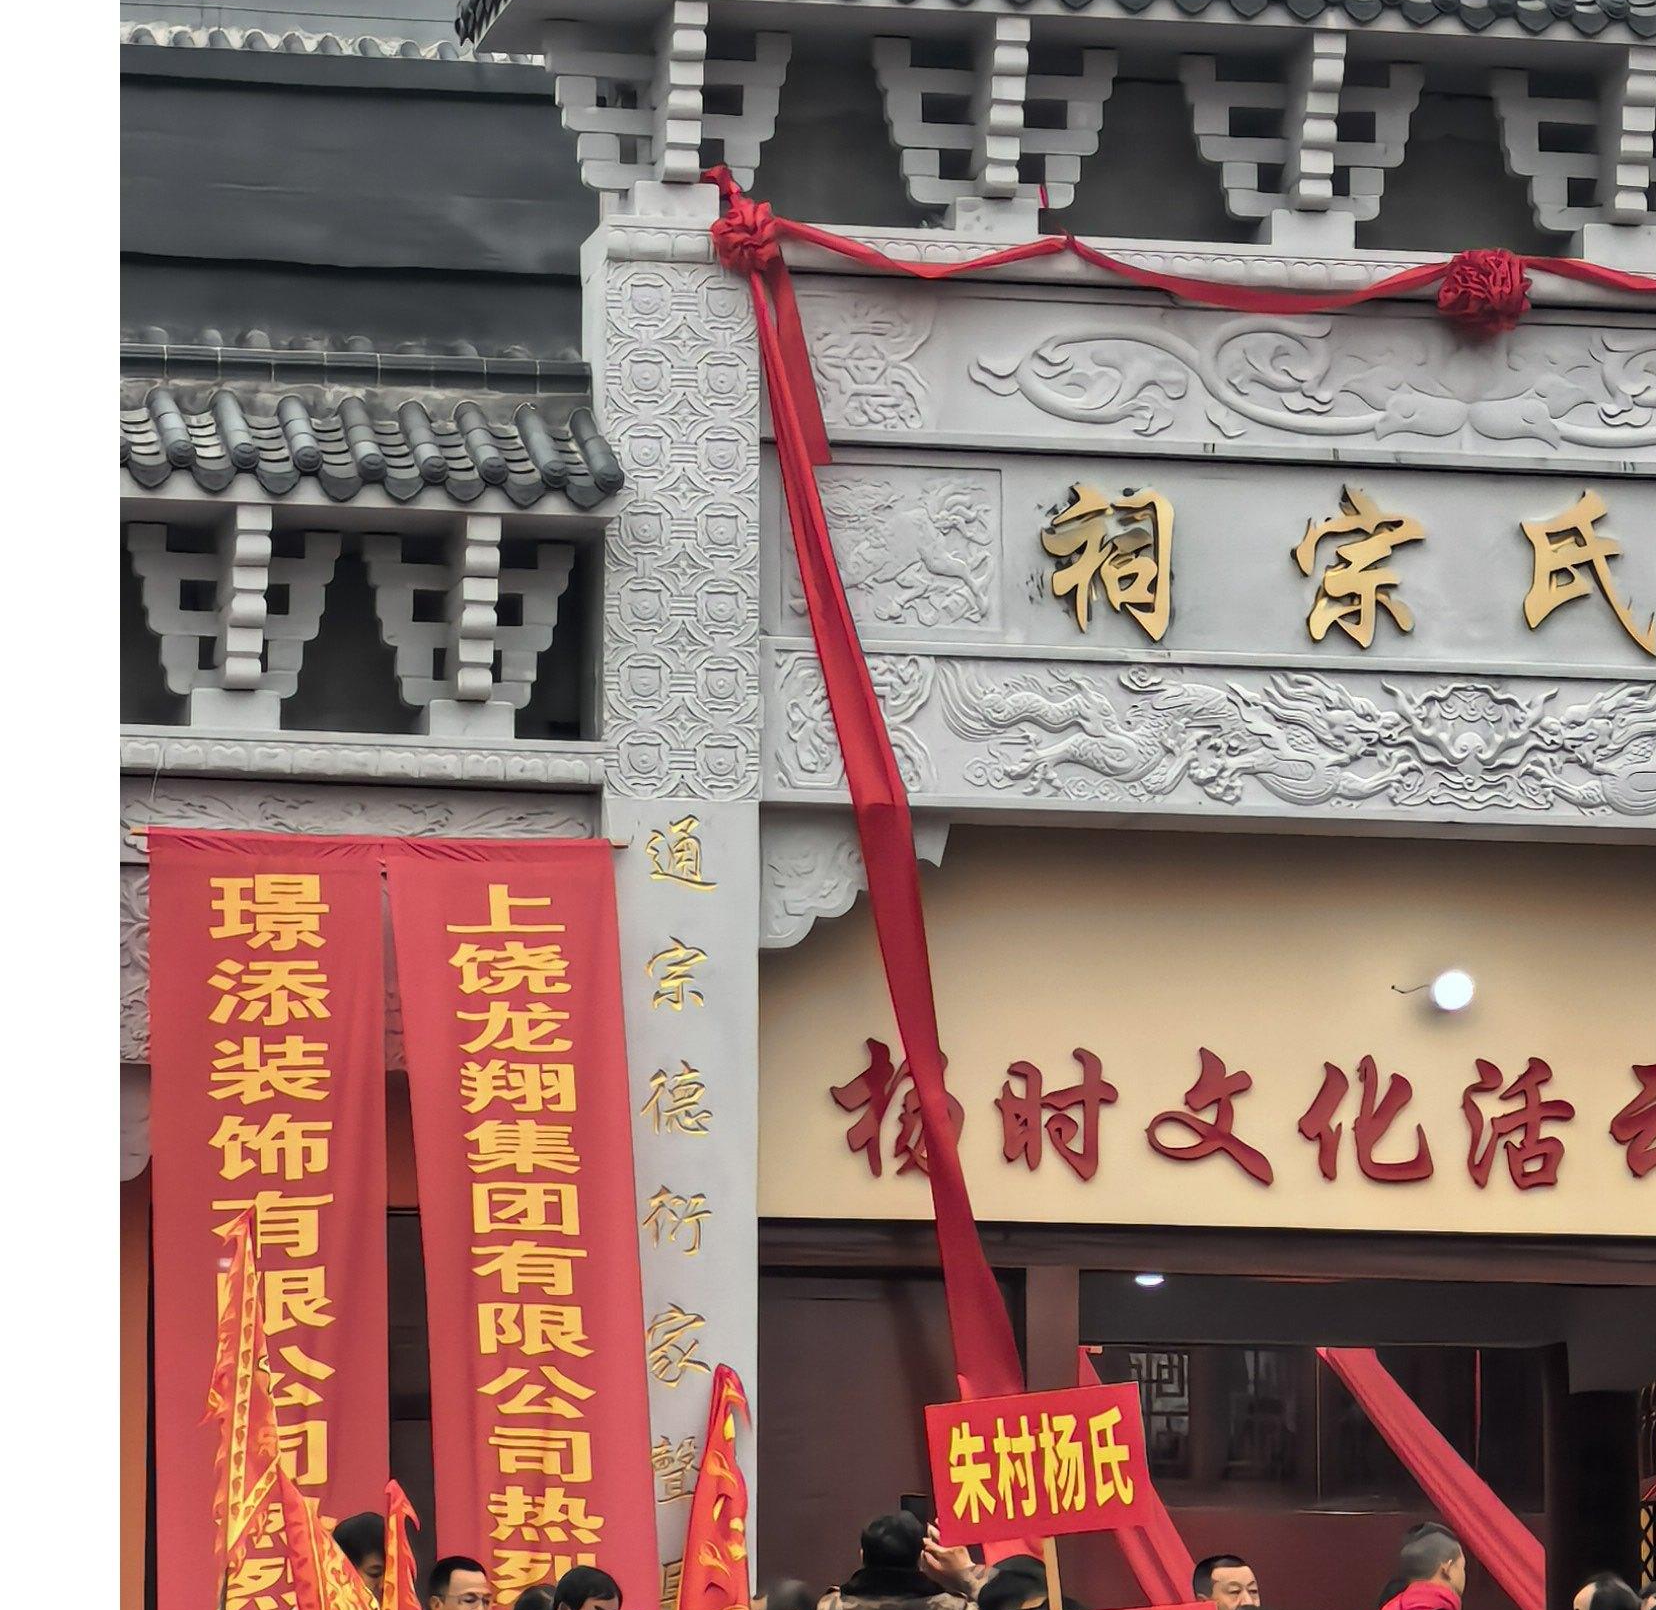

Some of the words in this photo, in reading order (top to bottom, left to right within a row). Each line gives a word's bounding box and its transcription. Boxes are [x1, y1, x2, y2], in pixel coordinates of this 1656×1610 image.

[447, 884, 605, 1605] 上饶龙翔集团有限公司热烈
[948, 1406, 1135, 1525] 朱村杨氏
